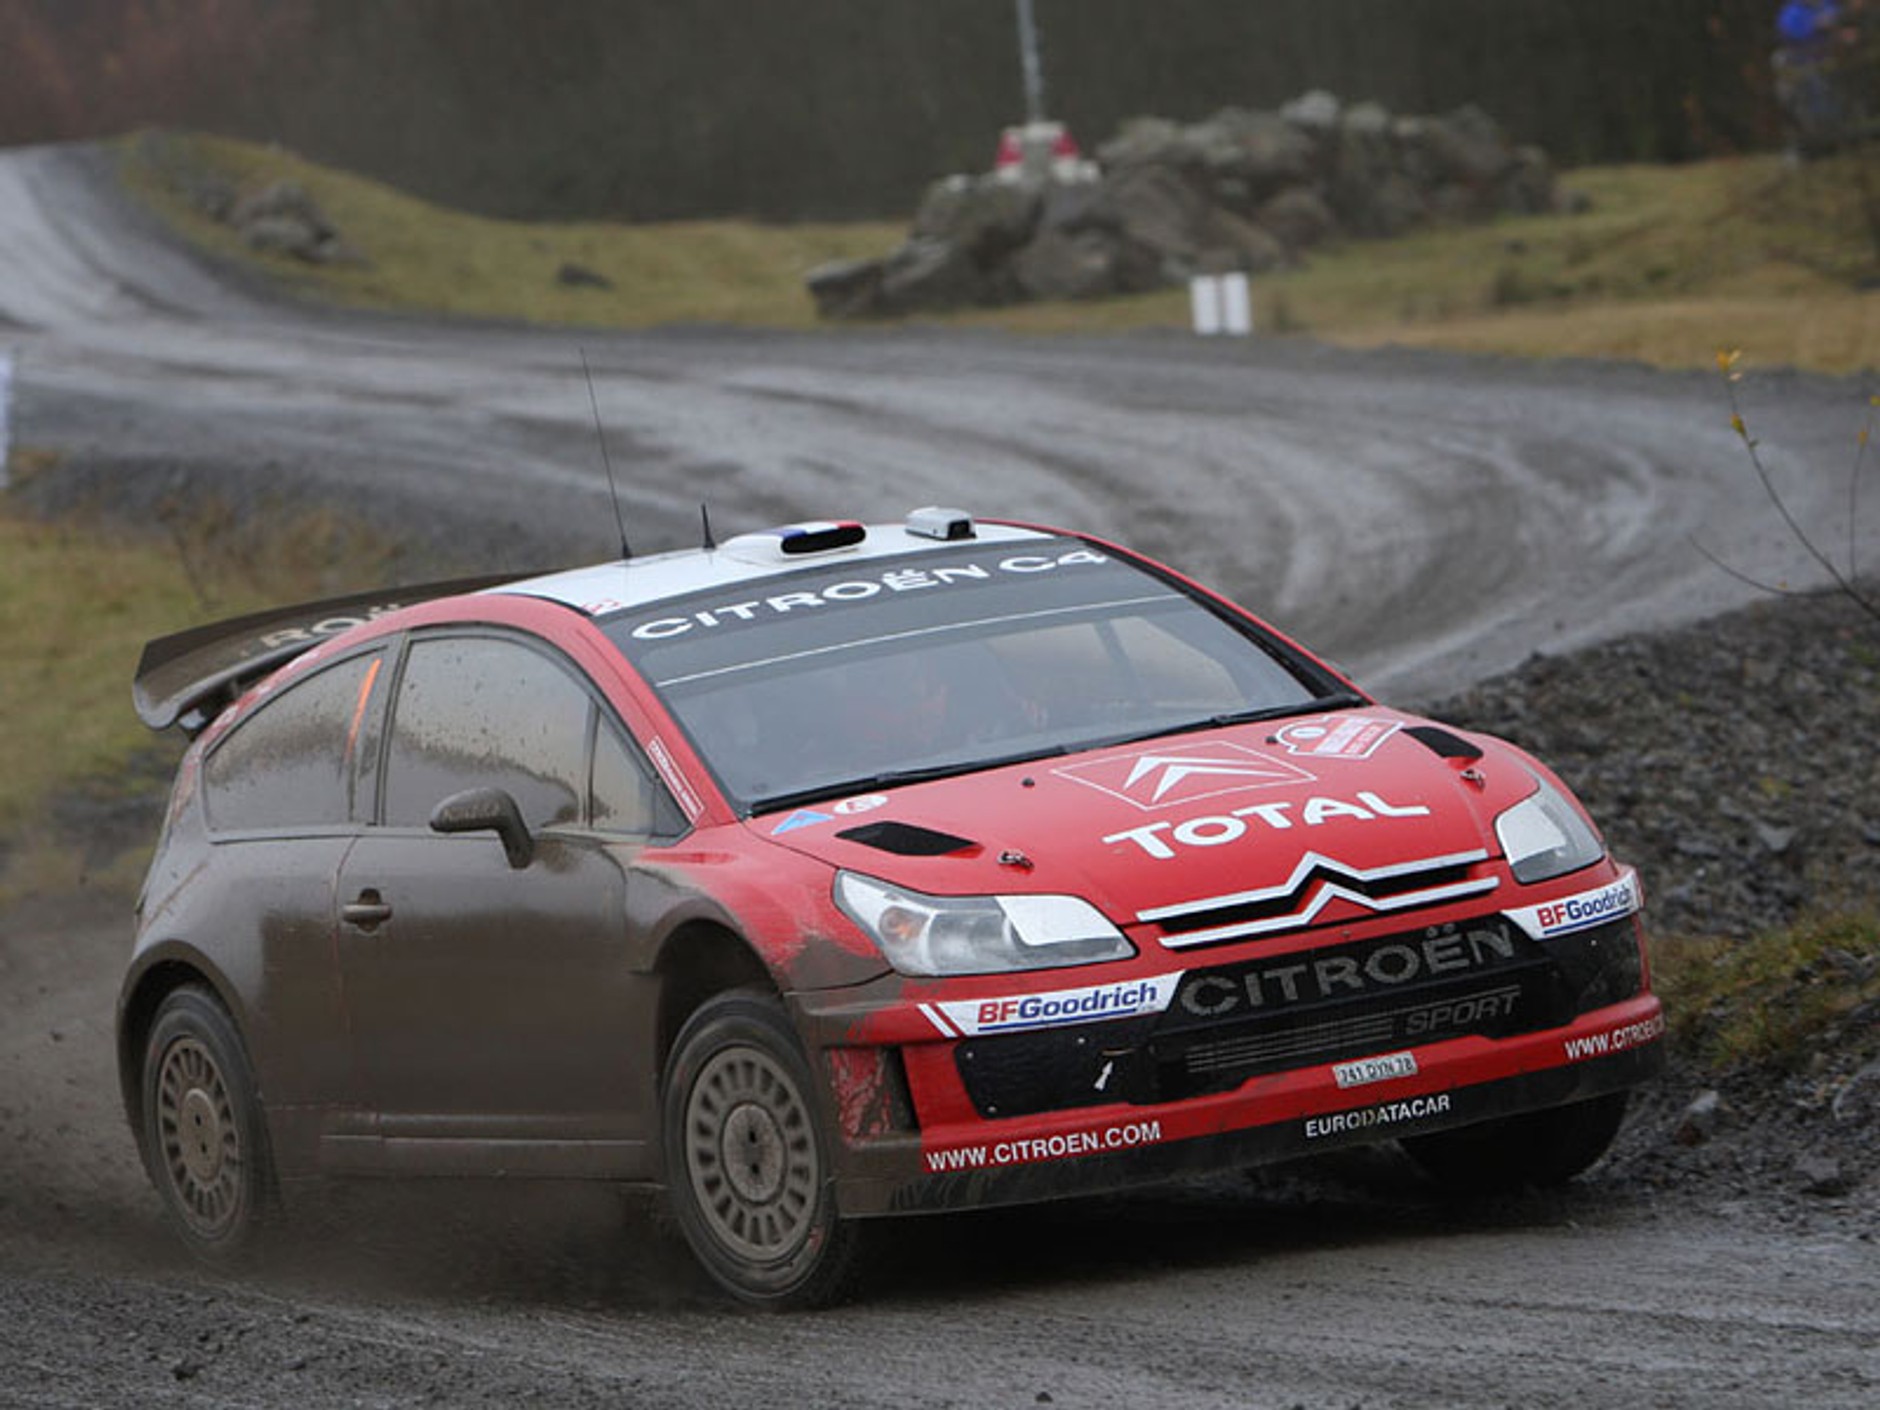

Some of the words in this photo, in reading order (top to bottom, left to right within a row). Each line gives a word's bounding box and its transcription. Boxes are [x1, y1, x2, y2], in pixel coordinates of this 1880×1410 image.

[631, 563, 990, 640] CITROËN
[999, 550, 1108, 573] C4
[1102, 791, 1430, 860] TOTAL
[1536, 884, 1631, 927] BFGoodrich
[1180, 922, 1516, 1016] CITROËN
[978, 983, 1157, 1024] BFGoodrich
[1405, 991, 1521, 1036] SPORT
[1305, 1094, 1451, 1138] EURODATACAR
[926, 1120, 1162, 1171] WWW.CITROEN.COM
